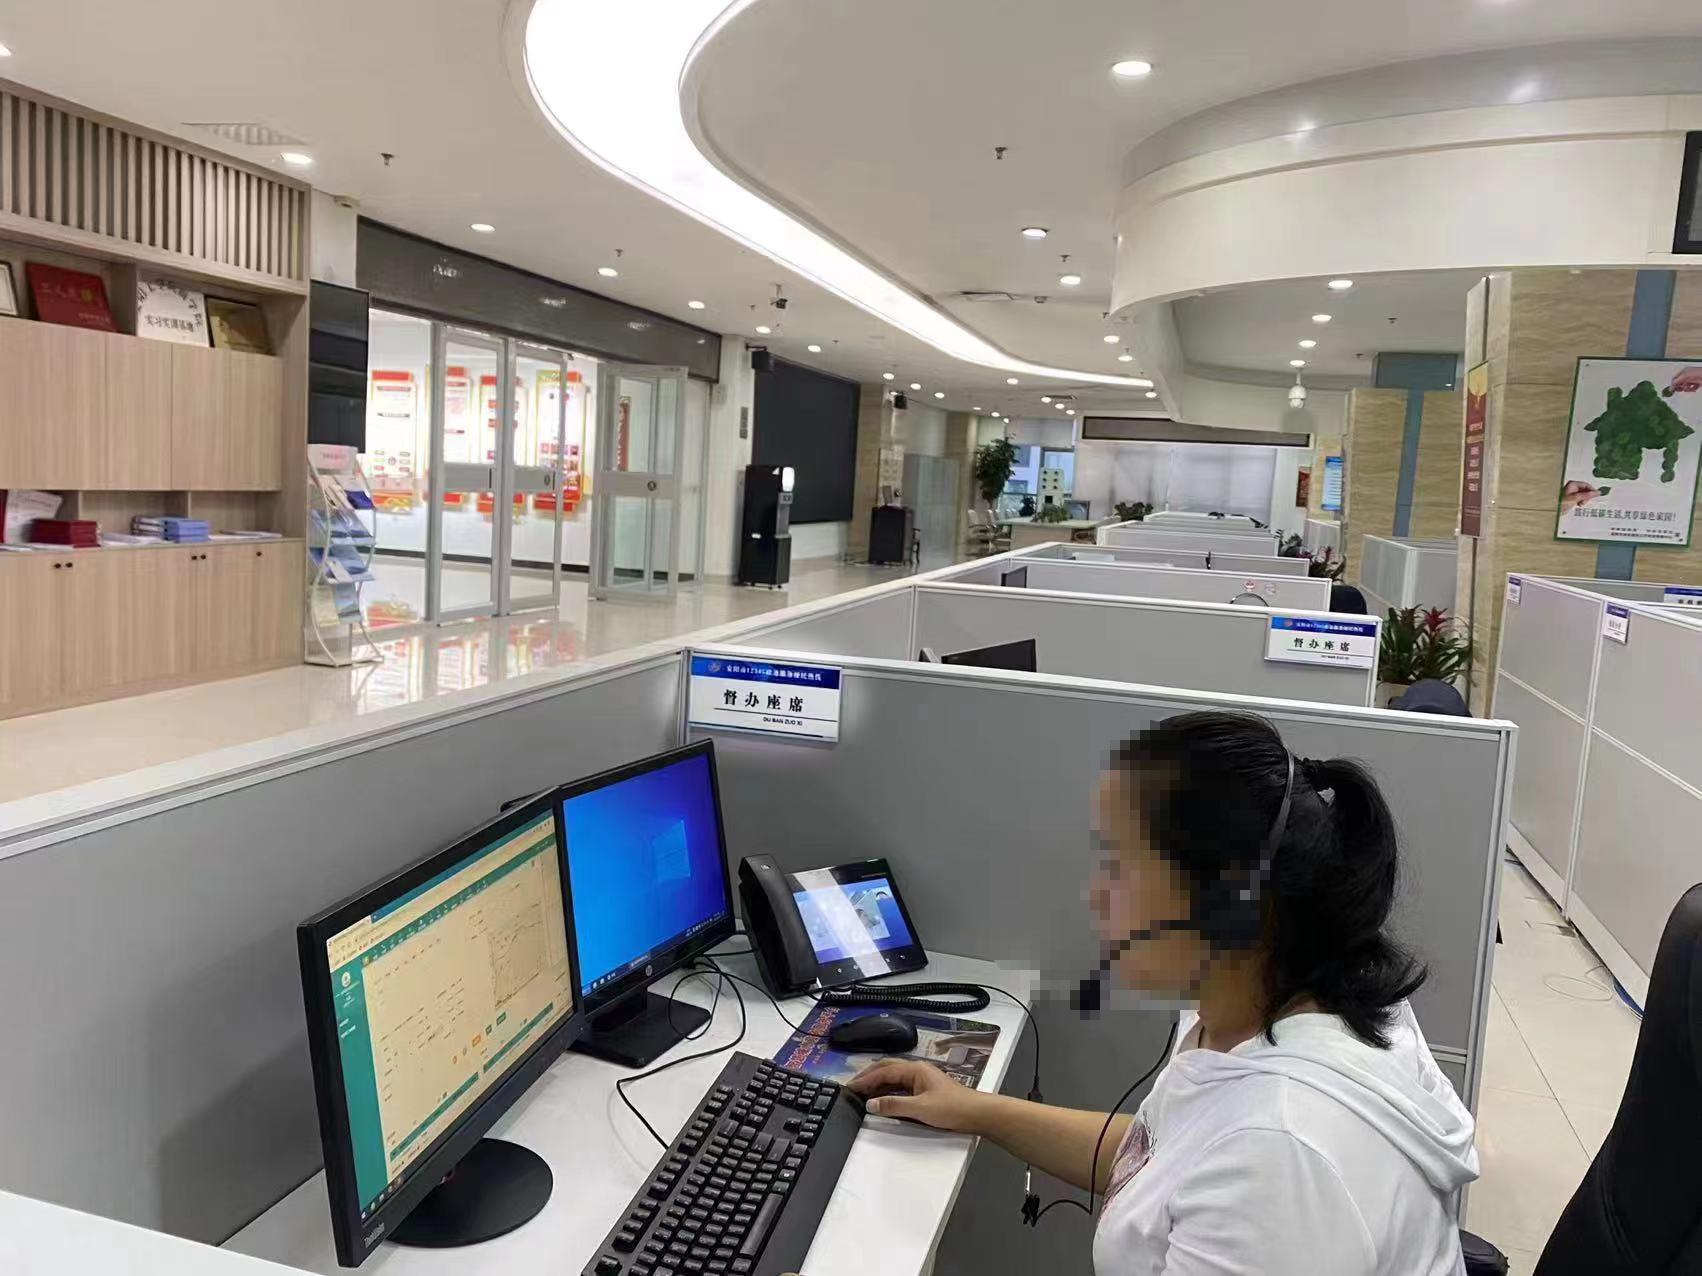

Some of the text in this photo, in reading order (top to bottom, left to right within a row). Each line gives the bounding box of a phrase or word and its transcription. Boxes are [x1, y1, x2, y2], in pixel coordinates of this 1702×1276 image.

[1294, 637, 1350, 652] 督办座席
[723, 689, 803, 713] 督办座席
